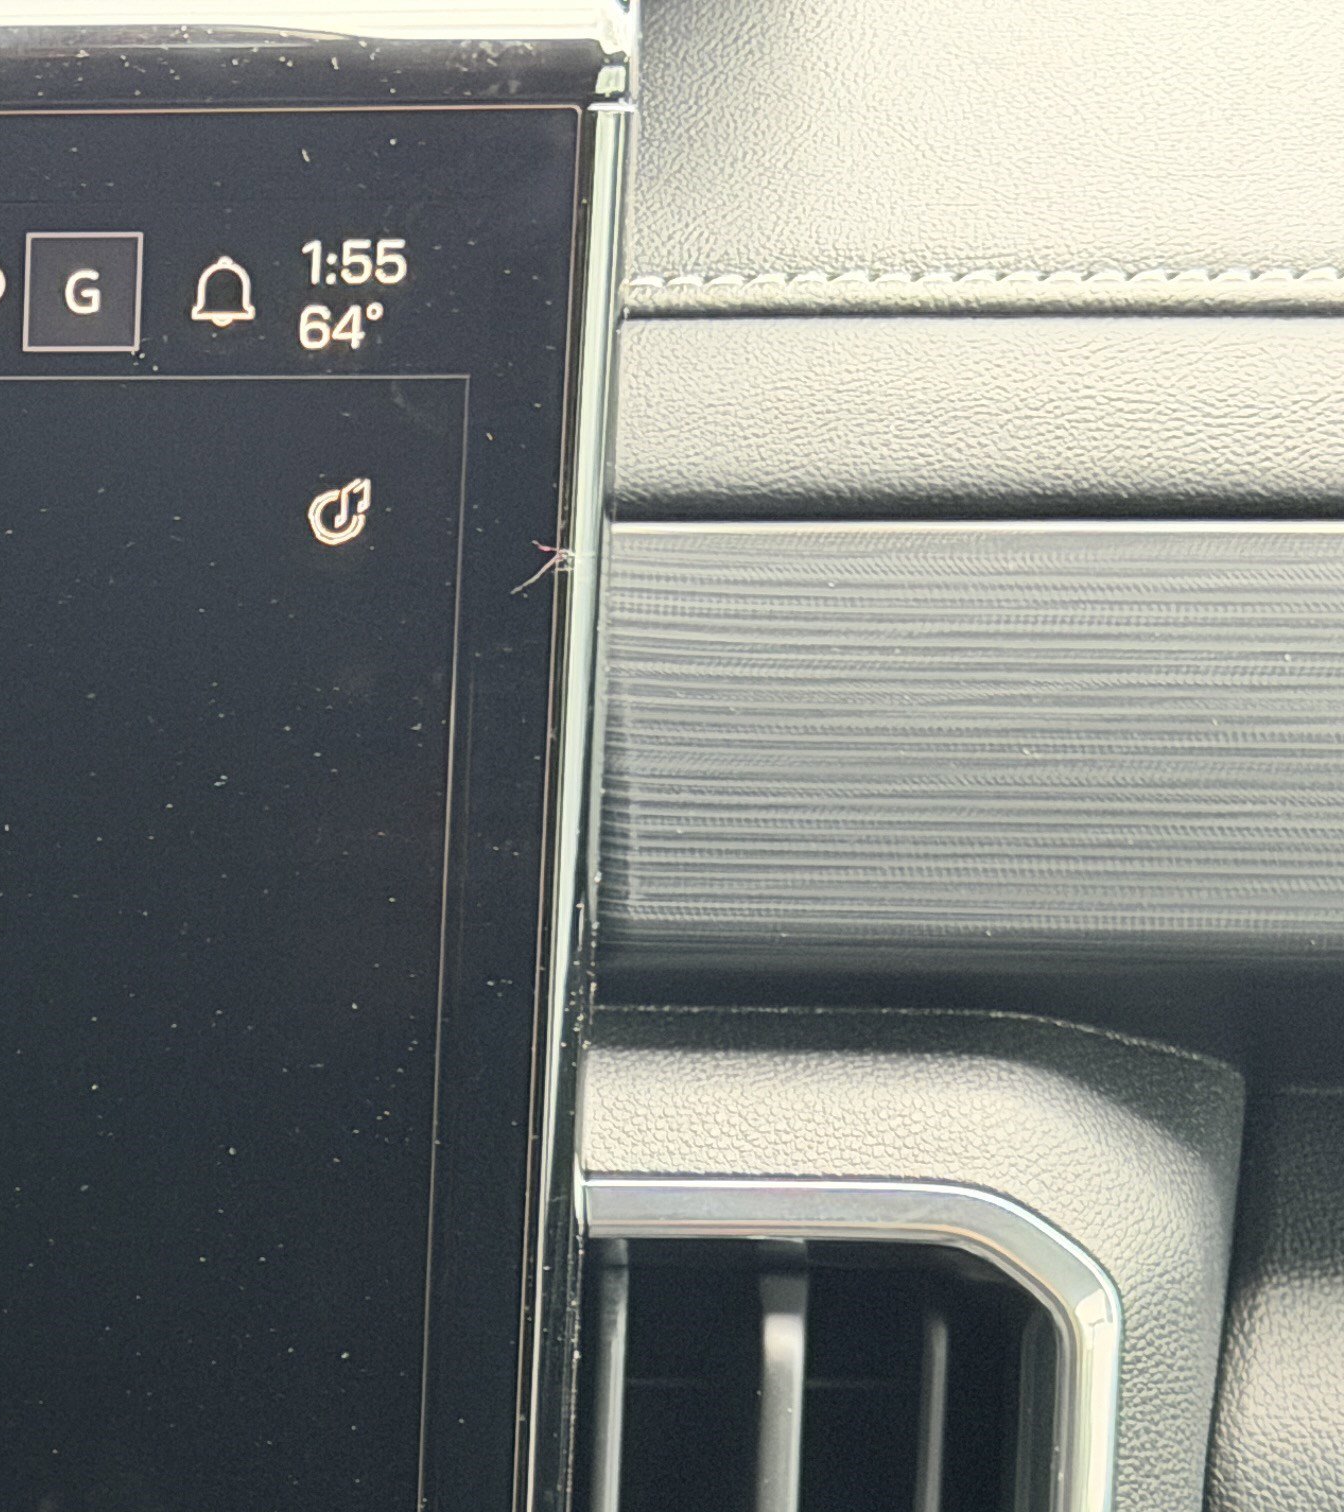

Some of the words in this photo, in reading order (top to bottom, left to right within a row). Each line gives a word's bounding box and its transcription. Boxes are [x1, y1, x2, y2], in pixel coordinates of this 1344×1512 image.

[300, 237, 409, 286] 1:55
[63, 267, 102, 316] G
[298, 300, 385, 351] 64°
